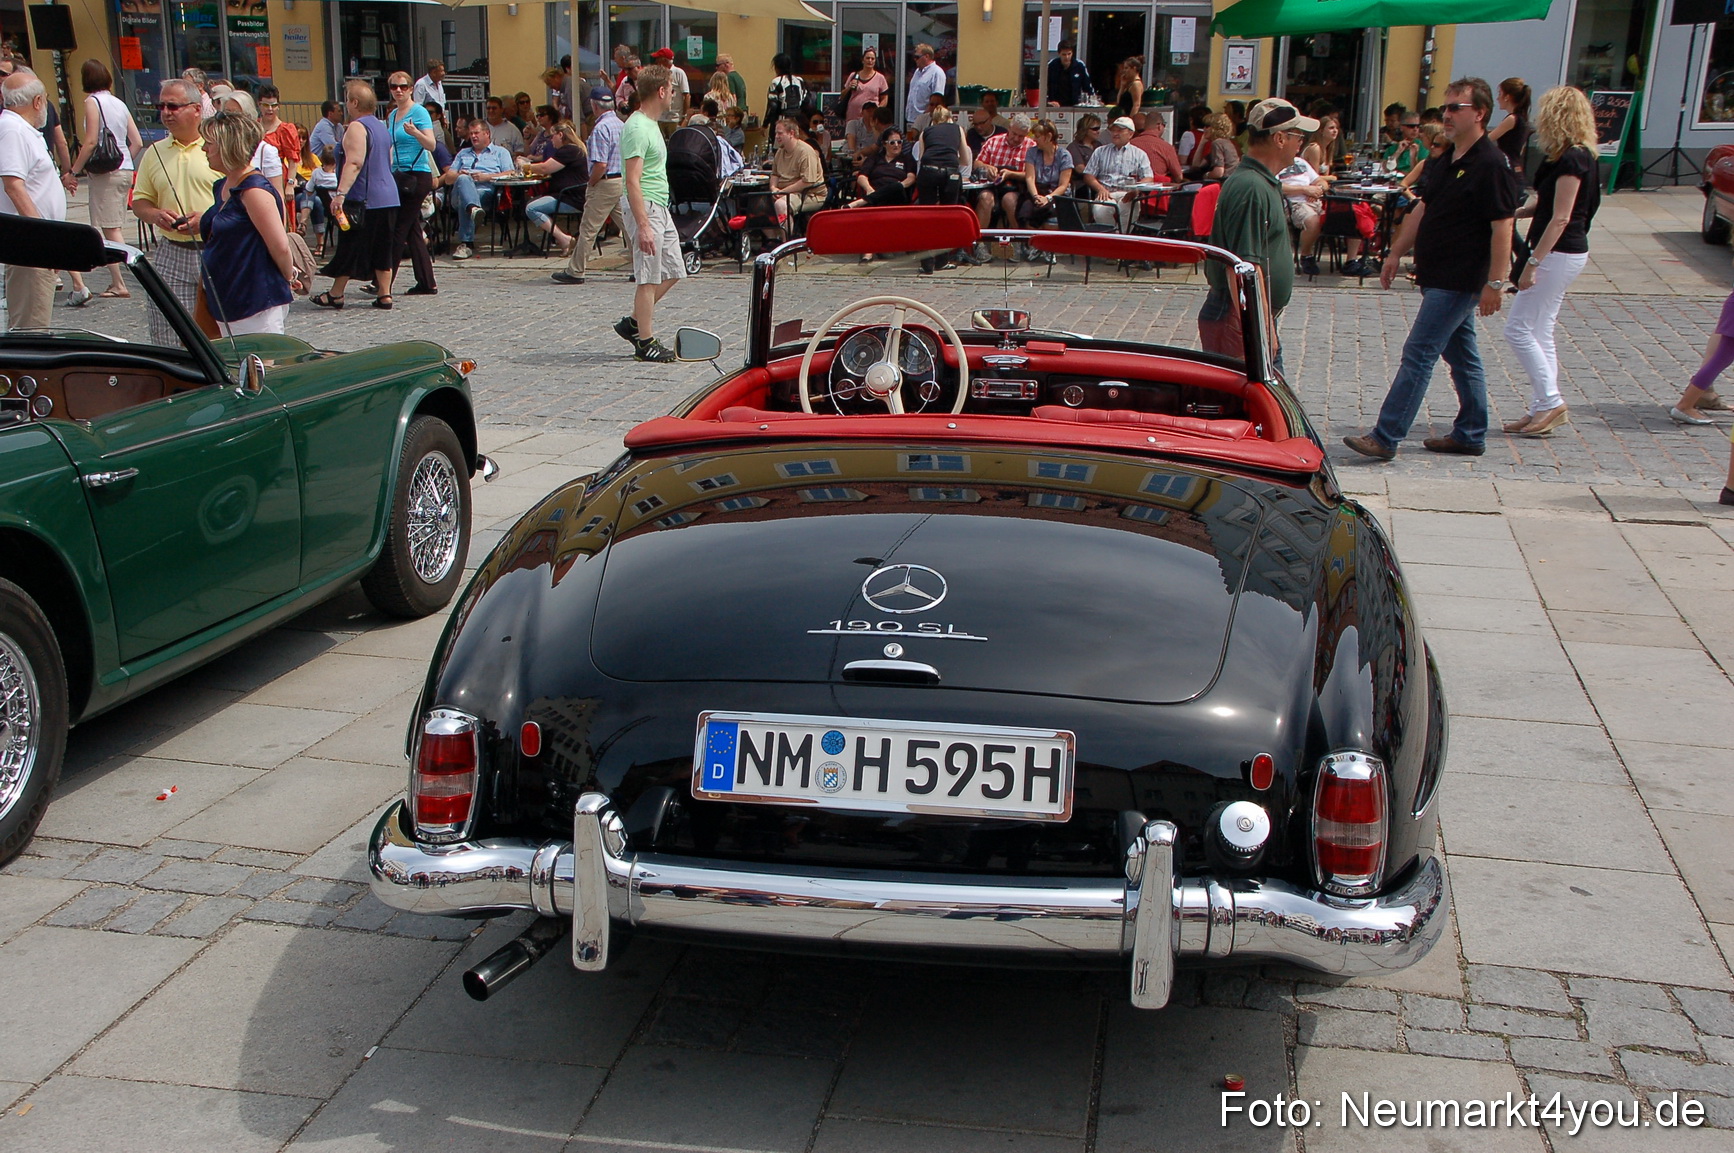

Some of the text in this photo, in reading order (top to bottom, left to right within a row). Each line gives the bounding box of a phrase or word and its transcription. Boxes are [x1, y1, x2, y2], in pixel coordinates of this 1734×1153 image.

[121, 16, 141, 24] Digitale
[829, 619, 968, 636] 190 SL
[736, 729, 813, 788] NM
[852, 736, 892, 793] H
[712, 763, 724, 779] D
